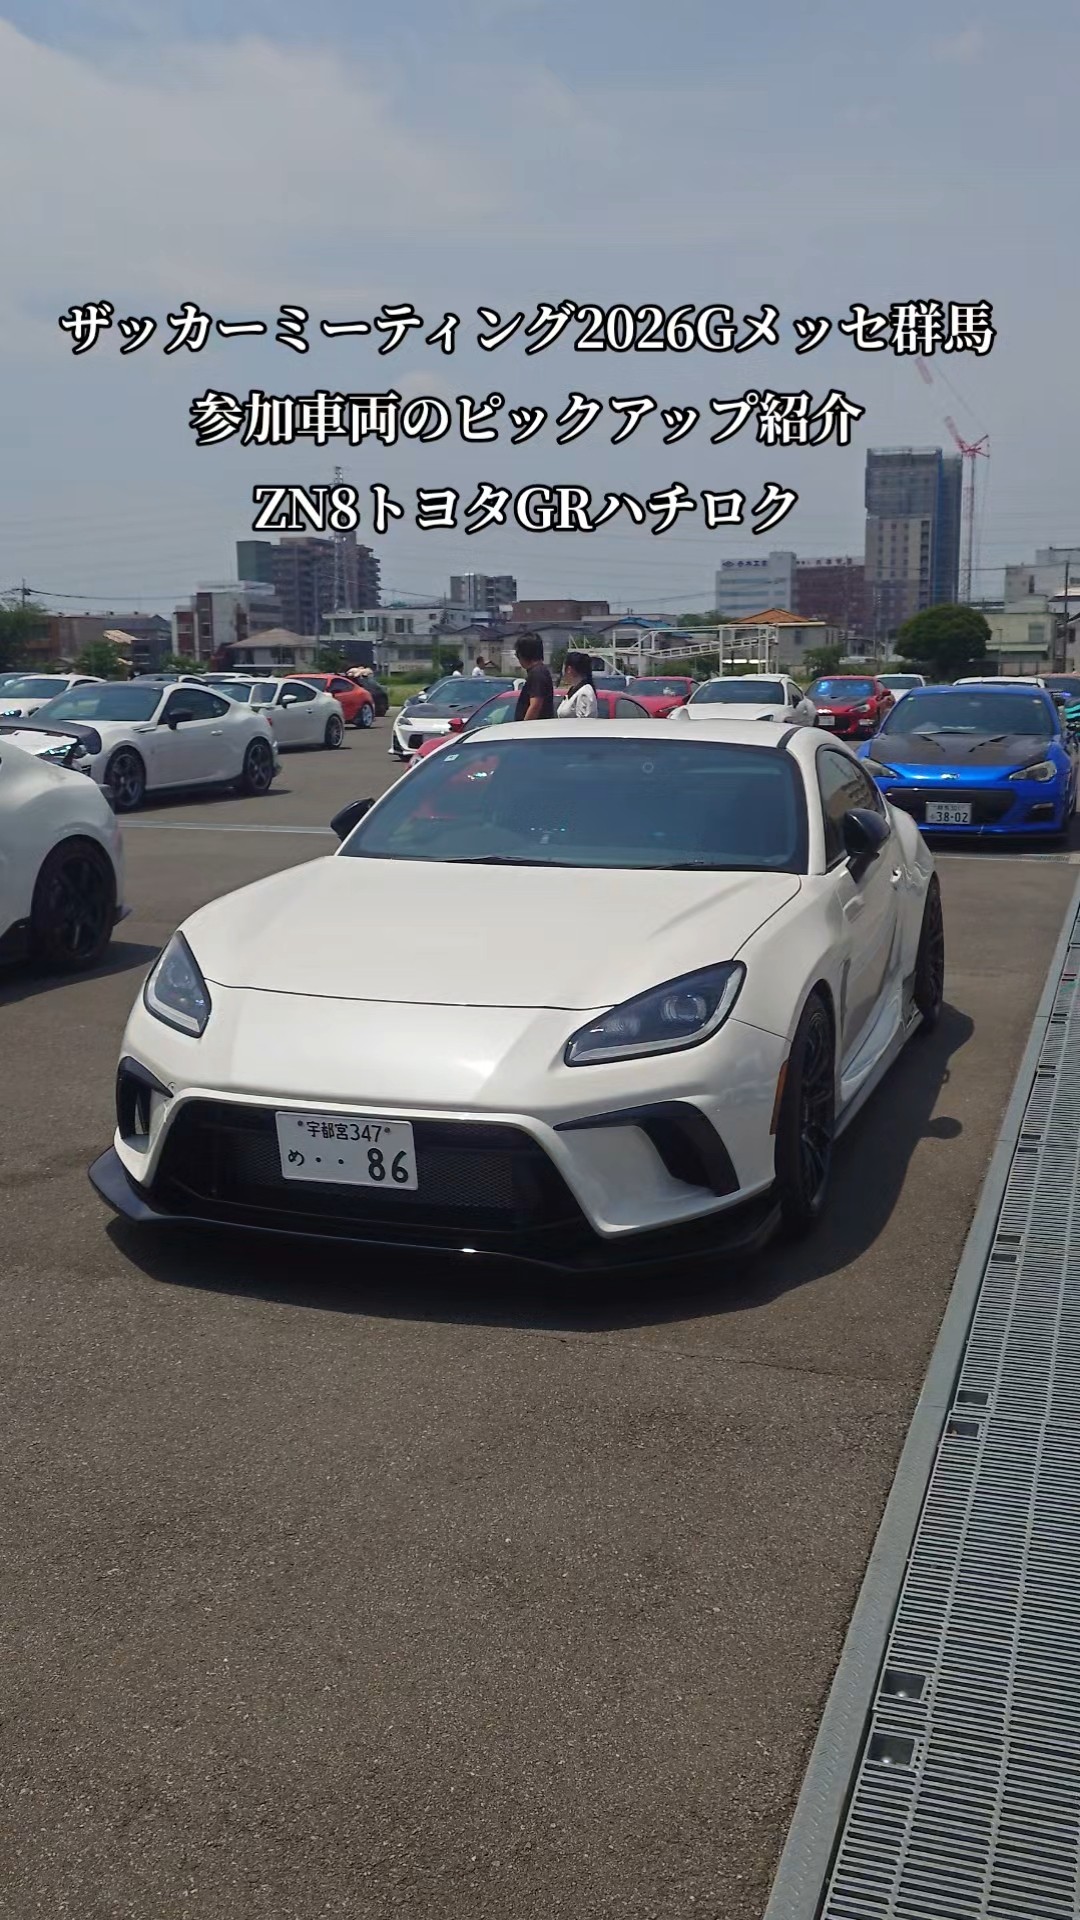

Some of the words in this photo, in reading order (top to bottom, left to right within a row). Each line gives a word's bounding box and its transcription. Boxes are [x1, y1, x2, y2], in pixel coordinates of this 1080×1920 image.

[306, 1121, 382, 1142] 宇都宮347
[367, 1147, 409, 1183] 86
